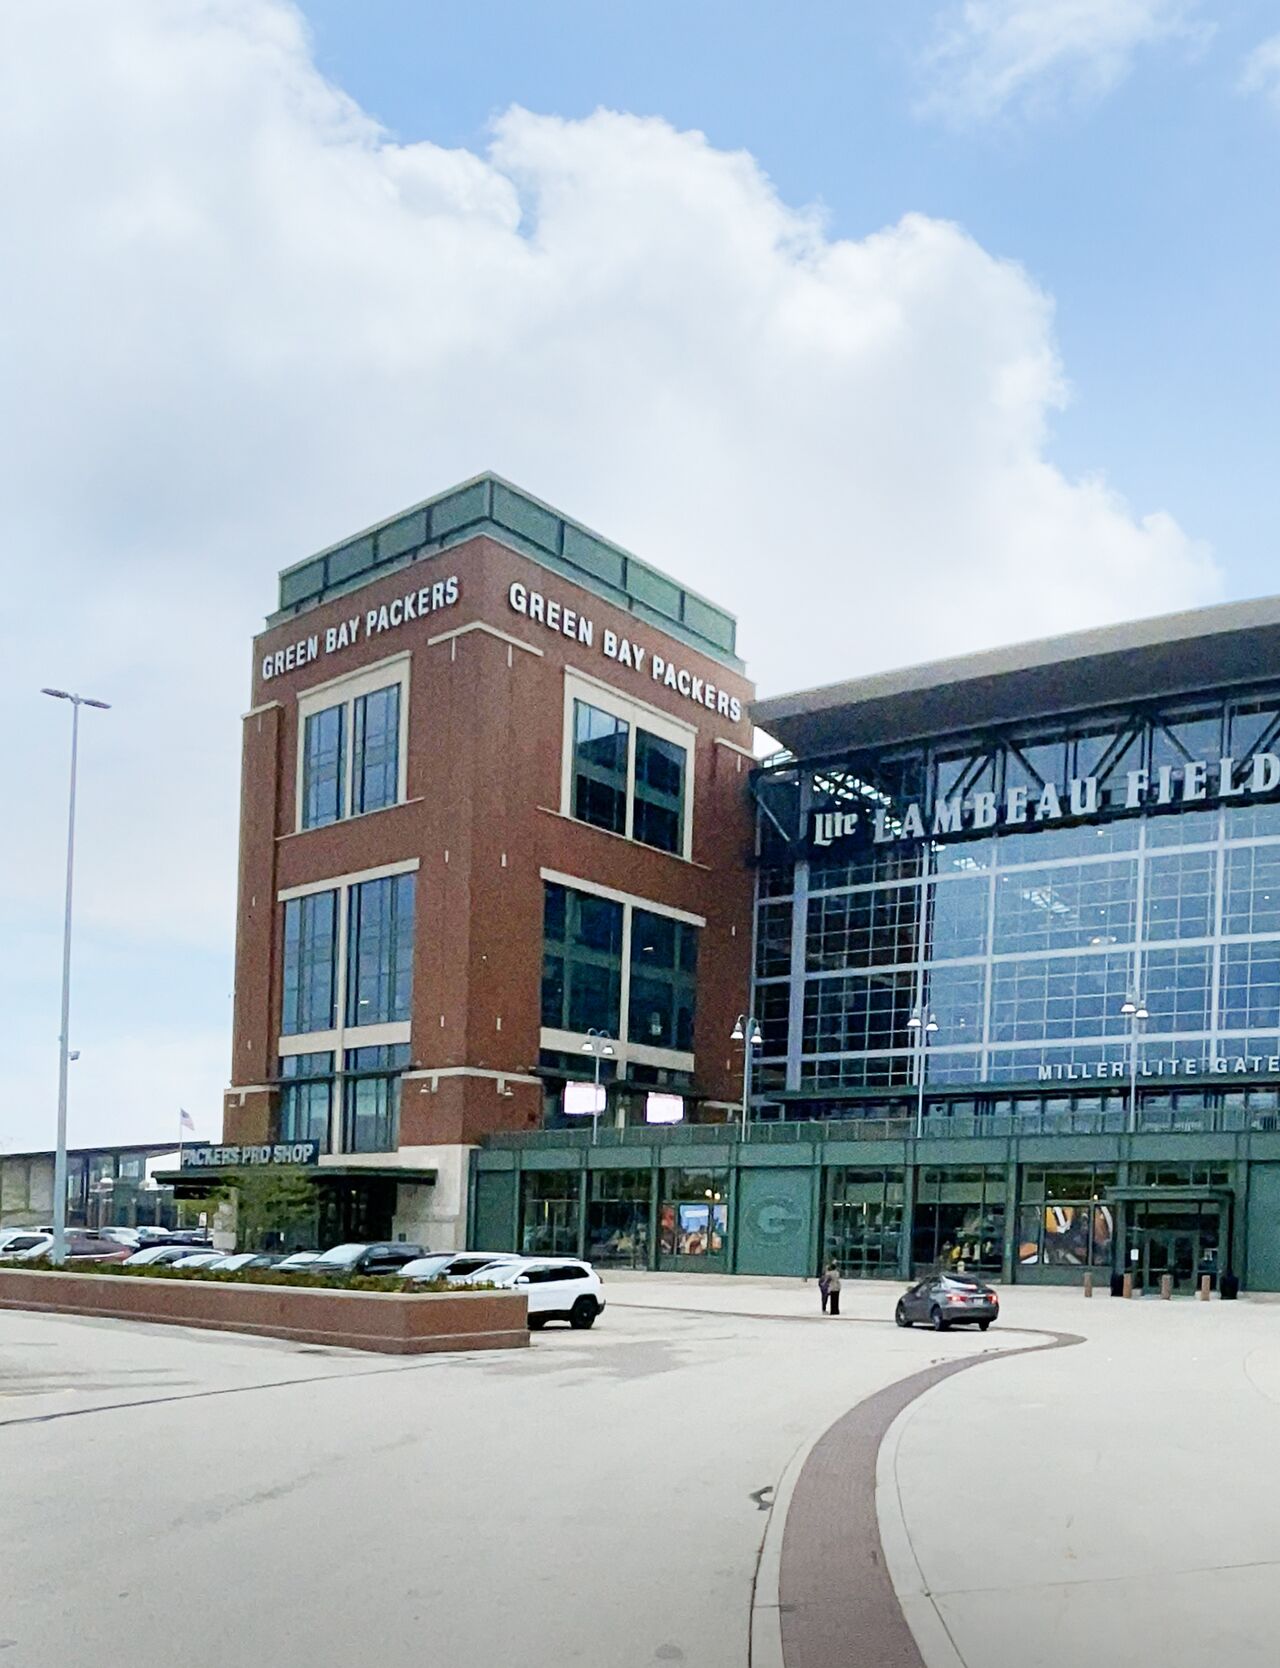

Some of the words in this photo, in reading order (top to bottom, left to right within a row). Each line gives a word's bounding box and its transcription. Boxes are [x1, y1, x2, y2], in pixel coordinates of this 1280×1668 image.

[262, 635, 319, 680] GREEN
[326, 616, 360, 654] BAY
[366, 576, 460, 637] PACKERS
[509, 582, 593, 647] GREEN
[603, 629, 646, 672] BAY
[652, 655, 742, 722] PACKERS
[814, 812, 860, 846] Lite
[873, 779, 1099, 843] LAMBEAU
[1038, 1062, 1124, 1080] MILLER
[1142, 1059, 1197, 1076] LITE
[1214, 1056, 1280, 1074] GATE
[182, 1147, 240, 1165] PACKERS
[242, 1145, 271, 1164] PRO
[274, 1144, 313, 1163] SHOP
